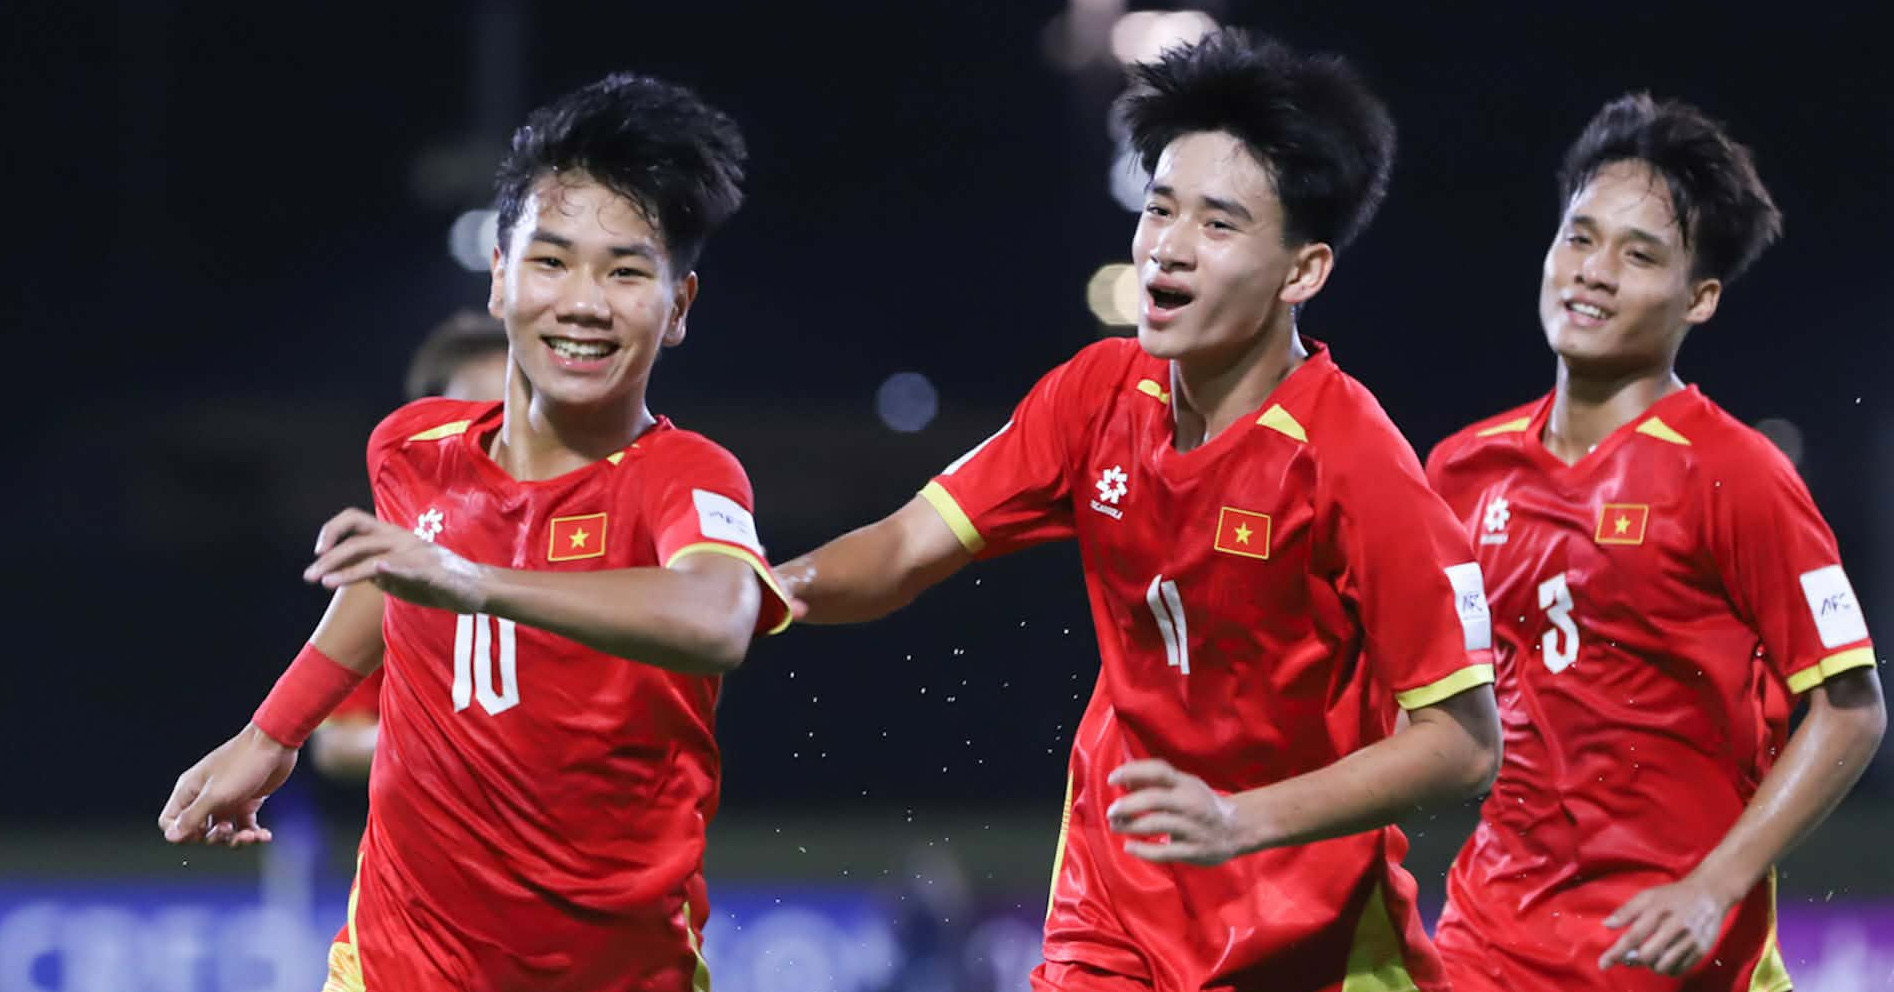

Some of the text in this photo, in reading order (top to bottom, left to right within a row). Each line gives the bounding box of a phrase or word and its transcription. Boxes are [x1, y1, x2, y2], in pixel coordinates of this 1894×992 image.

[451, 612, 520, 716] 10
[1146, 573, 1190, 675] 11
[1538, 572, 1580, 674] 3
